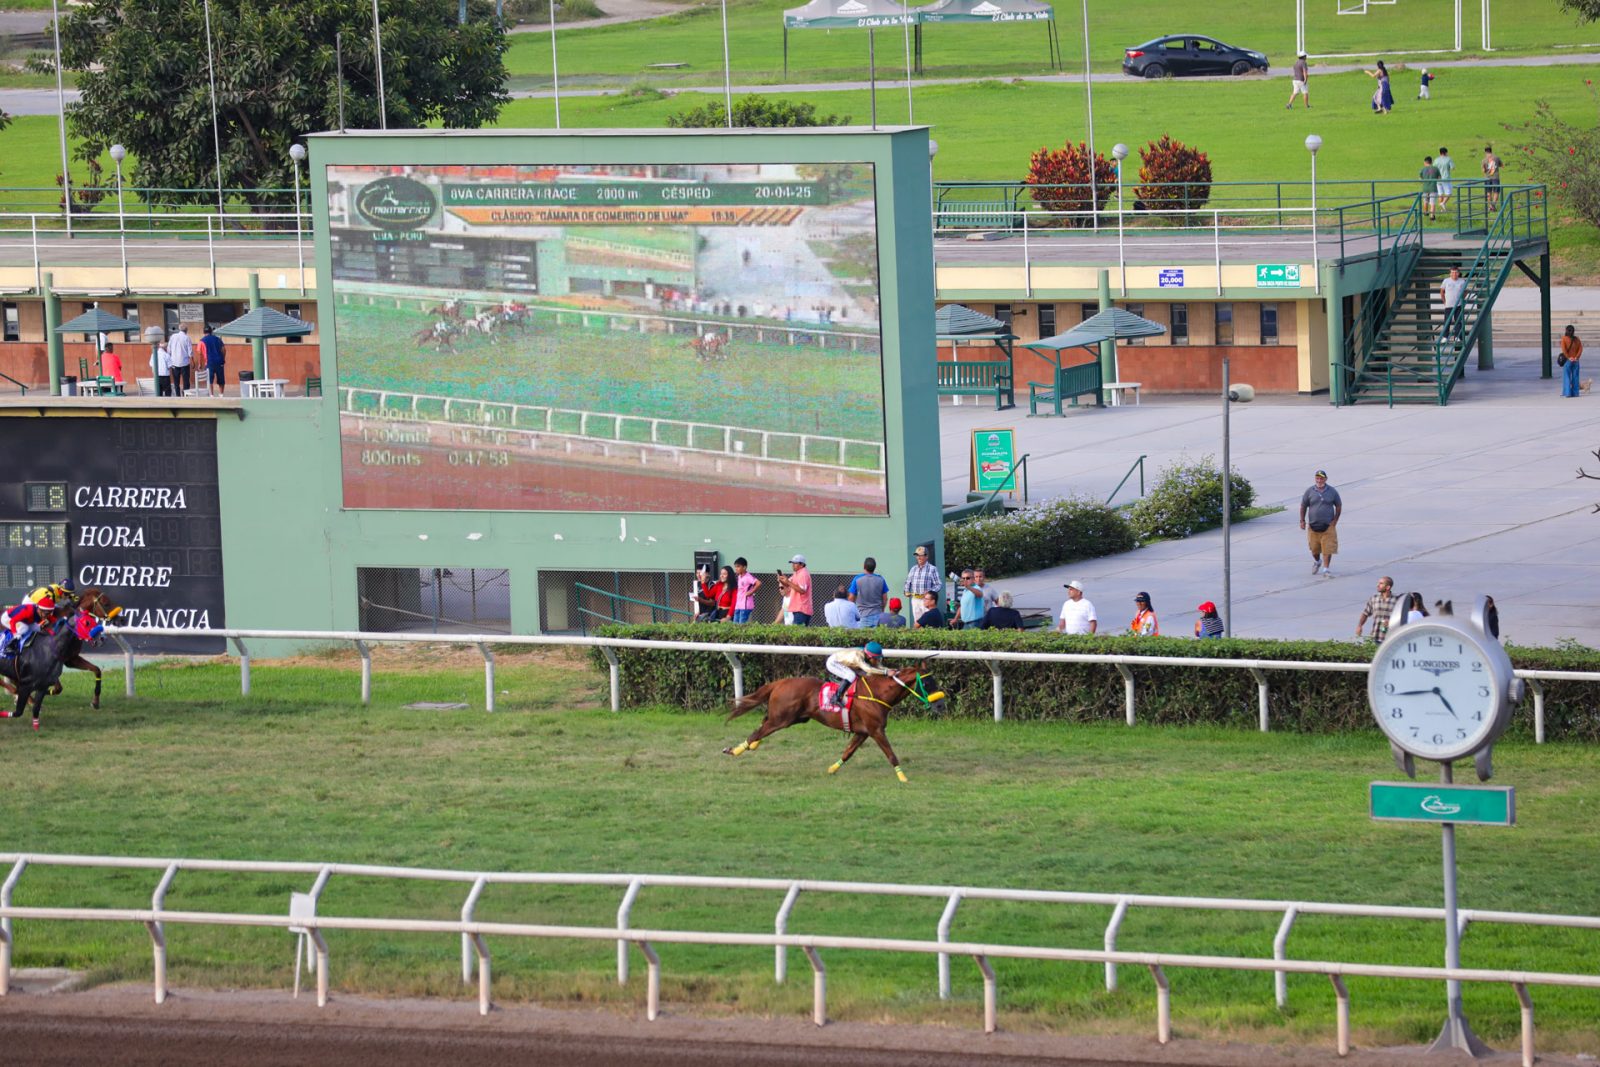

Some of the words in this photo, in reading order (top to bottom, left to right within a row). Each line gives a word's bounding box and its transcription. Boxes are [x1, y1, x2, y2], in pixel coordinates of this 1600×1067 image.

[858, 18, 867, 27] El
[866, 17, 880, 26] Club
[882, 17, 890, 25] de
[1001, 12, 1015, 21] Club
[1016, 12, 1025, 20] de
[476, 188, 534, 200] CARRERA
[543, 187, 577, 200] RACE
[597, 188, 625, 199] 2000
[627, 191, 639, 199] m
[582, 211, 594, 221] DE
[595, 211, 645, 221] COMERCIO
[646, 211, 660, 221] DE
[361, 450, 421, 465] 800mts
[49, 486, 64, 508] 8
[74, 486, 187, 509] CARRERA
[9, 525, 67, 548] 4:33
[78, 526, 146, 547] HORA
[79, 565, 172, 587] CIERRE
[119, 608, 211, 629] TANCIA
[1407, 642, 1417, 653] 11
[1428, 636, 1443, 648] 12
[1458, 644, 1463, 655] 1
[1391, 659, 1405, 669] 10
[1412, 659, 1461, 669] LONGINES
[1471, 661, 1482, 672] 2
[1384, 683, 1395, 695] 9
[1478, 686, 1490, 698] 3
[1391, 707, 1403, 719] 8
[1471, 711, 1482, 721] 4
[1409, 726, 1419, 738] 7
[1456, 728, 1466, 740] 5
[1432, 733, 1443, 745] 6
